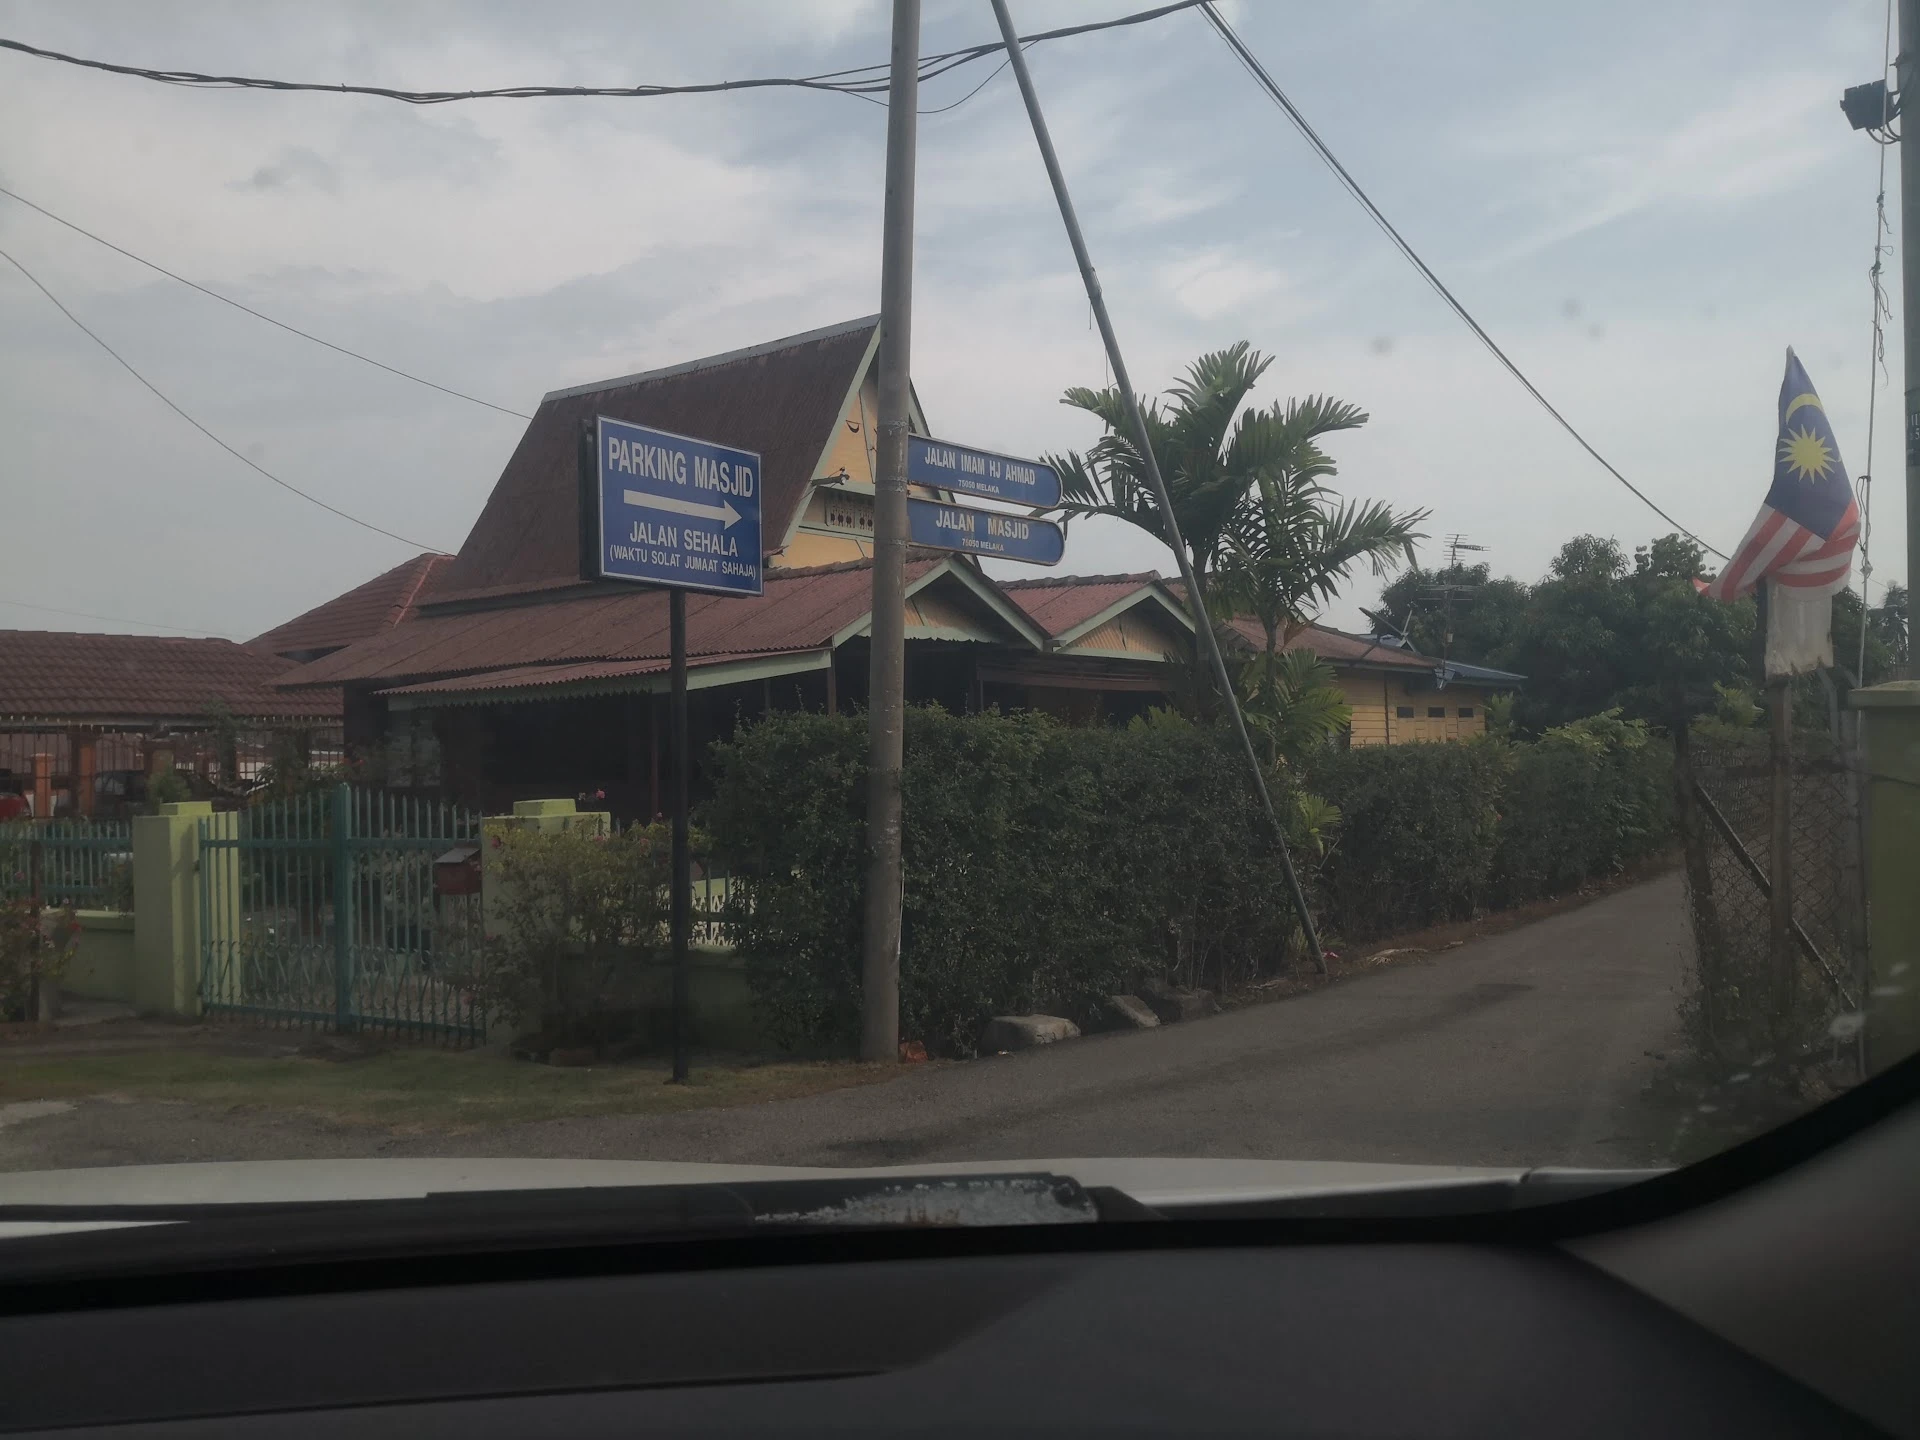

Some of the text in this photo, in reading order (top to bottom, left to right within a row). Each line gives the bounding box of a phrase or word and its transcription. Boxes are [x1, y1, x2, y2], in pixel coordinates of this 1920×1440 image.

[608, 436, 753, 498] PARKING MASJID
[925, 447, 1036, 486] JALAN IMAM HJ AHMAD
[976, 482, 1000, 494] MELAKA
[630, 520, 738, 557] JALAN SEHALA
[935, 508, 1029, 540] JALAN MASJID
[609, 544, 756, 580] (WAKTU SOLAT JUMAAT SAHAJA)
[981, 540, 1004, 552] MELAKA
